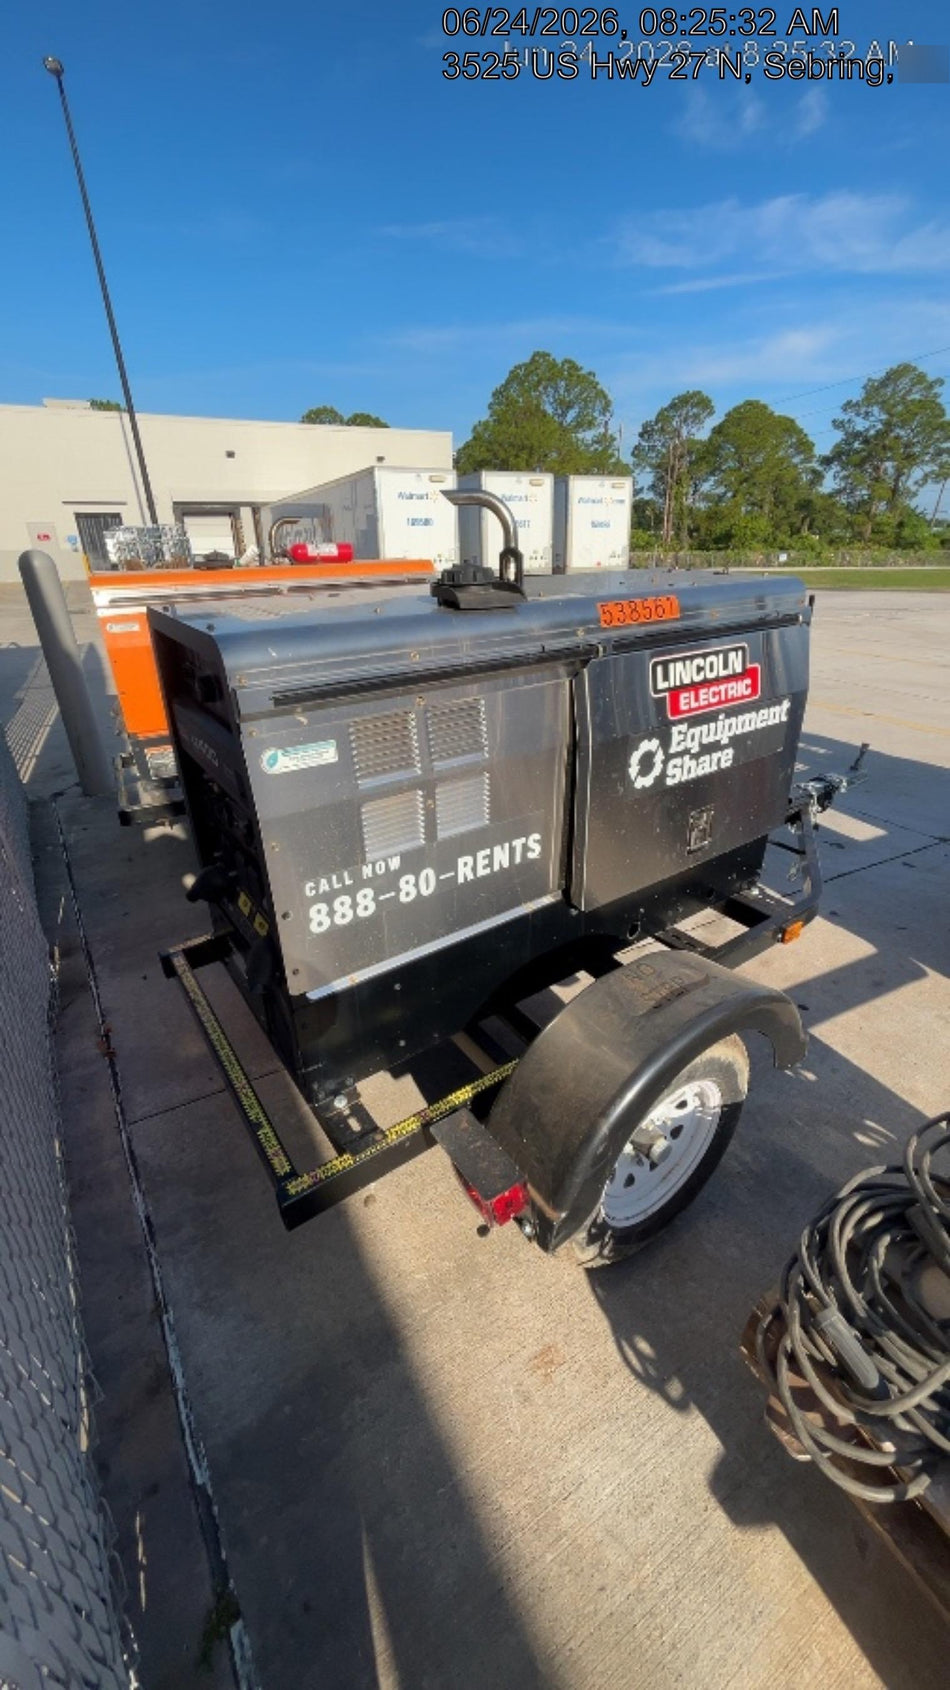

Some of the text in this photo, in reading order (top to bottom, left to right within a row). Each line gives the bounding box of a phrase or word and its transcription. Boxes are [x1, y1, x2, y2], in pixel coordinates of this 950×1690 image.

[656, 649, 743, 690] LINCOLN
[679, 678, 752, 711] ELECTRIC
[668, 698, 791, 753] Equipment
[666, 746, 735, 786] Share
[304, 855, 401, 898] CALL NOW
[309, 833, 542, 933] 888-80-RENTS
